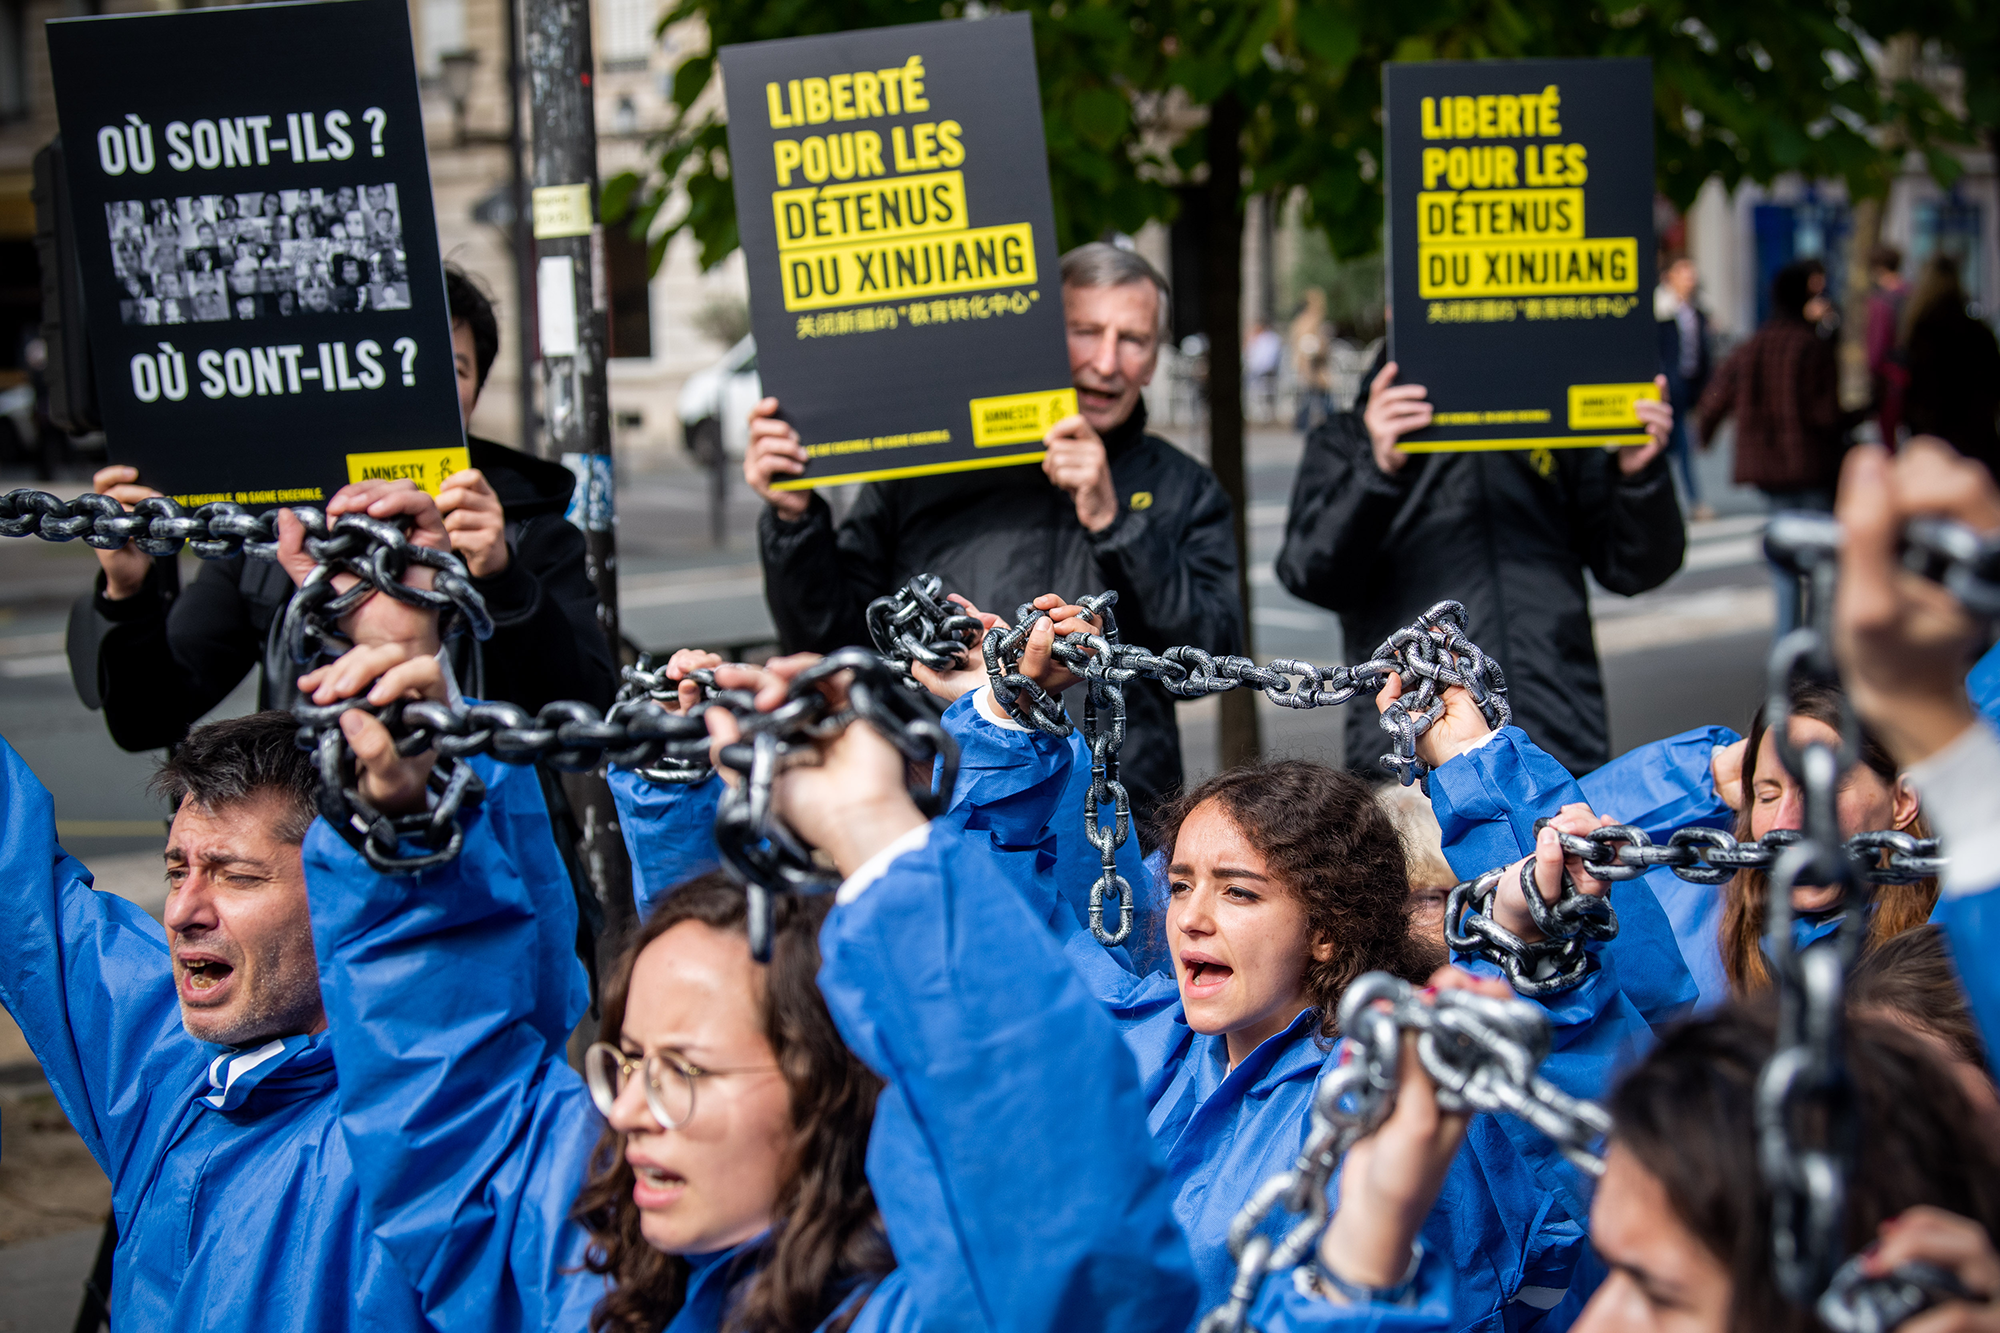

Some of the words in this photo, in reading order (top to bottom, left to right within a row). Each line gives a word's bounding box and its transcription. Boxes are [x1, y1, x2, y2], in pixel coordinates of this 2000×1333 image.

[766, 55, 930, 129] LIBERTÉ
[1421, 85, 1562, 140] LIBERTÉ
[97, 113, 154, 176] OÙ
[165, 109, 354, 171] SONT-ILS
[362, 106, 387, 157] ?
[773, 130, 885, 187] POUR
[891, 120, 966, 174] LES
[1422, 145, 1519, 190] POUR
[1524, 143, 1588, 187] LES
[785, 184, 953, 240] DÉTENUS
[1428, 190, 1572, 235] DÉTENUS
[792, 257, 840, 300] DU
[857, 236, 1025, 292] XINJIANG
[1430, 254, 1470, 288] DU
[1484, 248, 1628, 284] XINJIANG
[130, 341, 188, 402] OÙ
[197, 337, 385, 398] SONT-ILS
[392, 335, 418, 386] ?
[362, 463, 424, 481] AMNESTY
